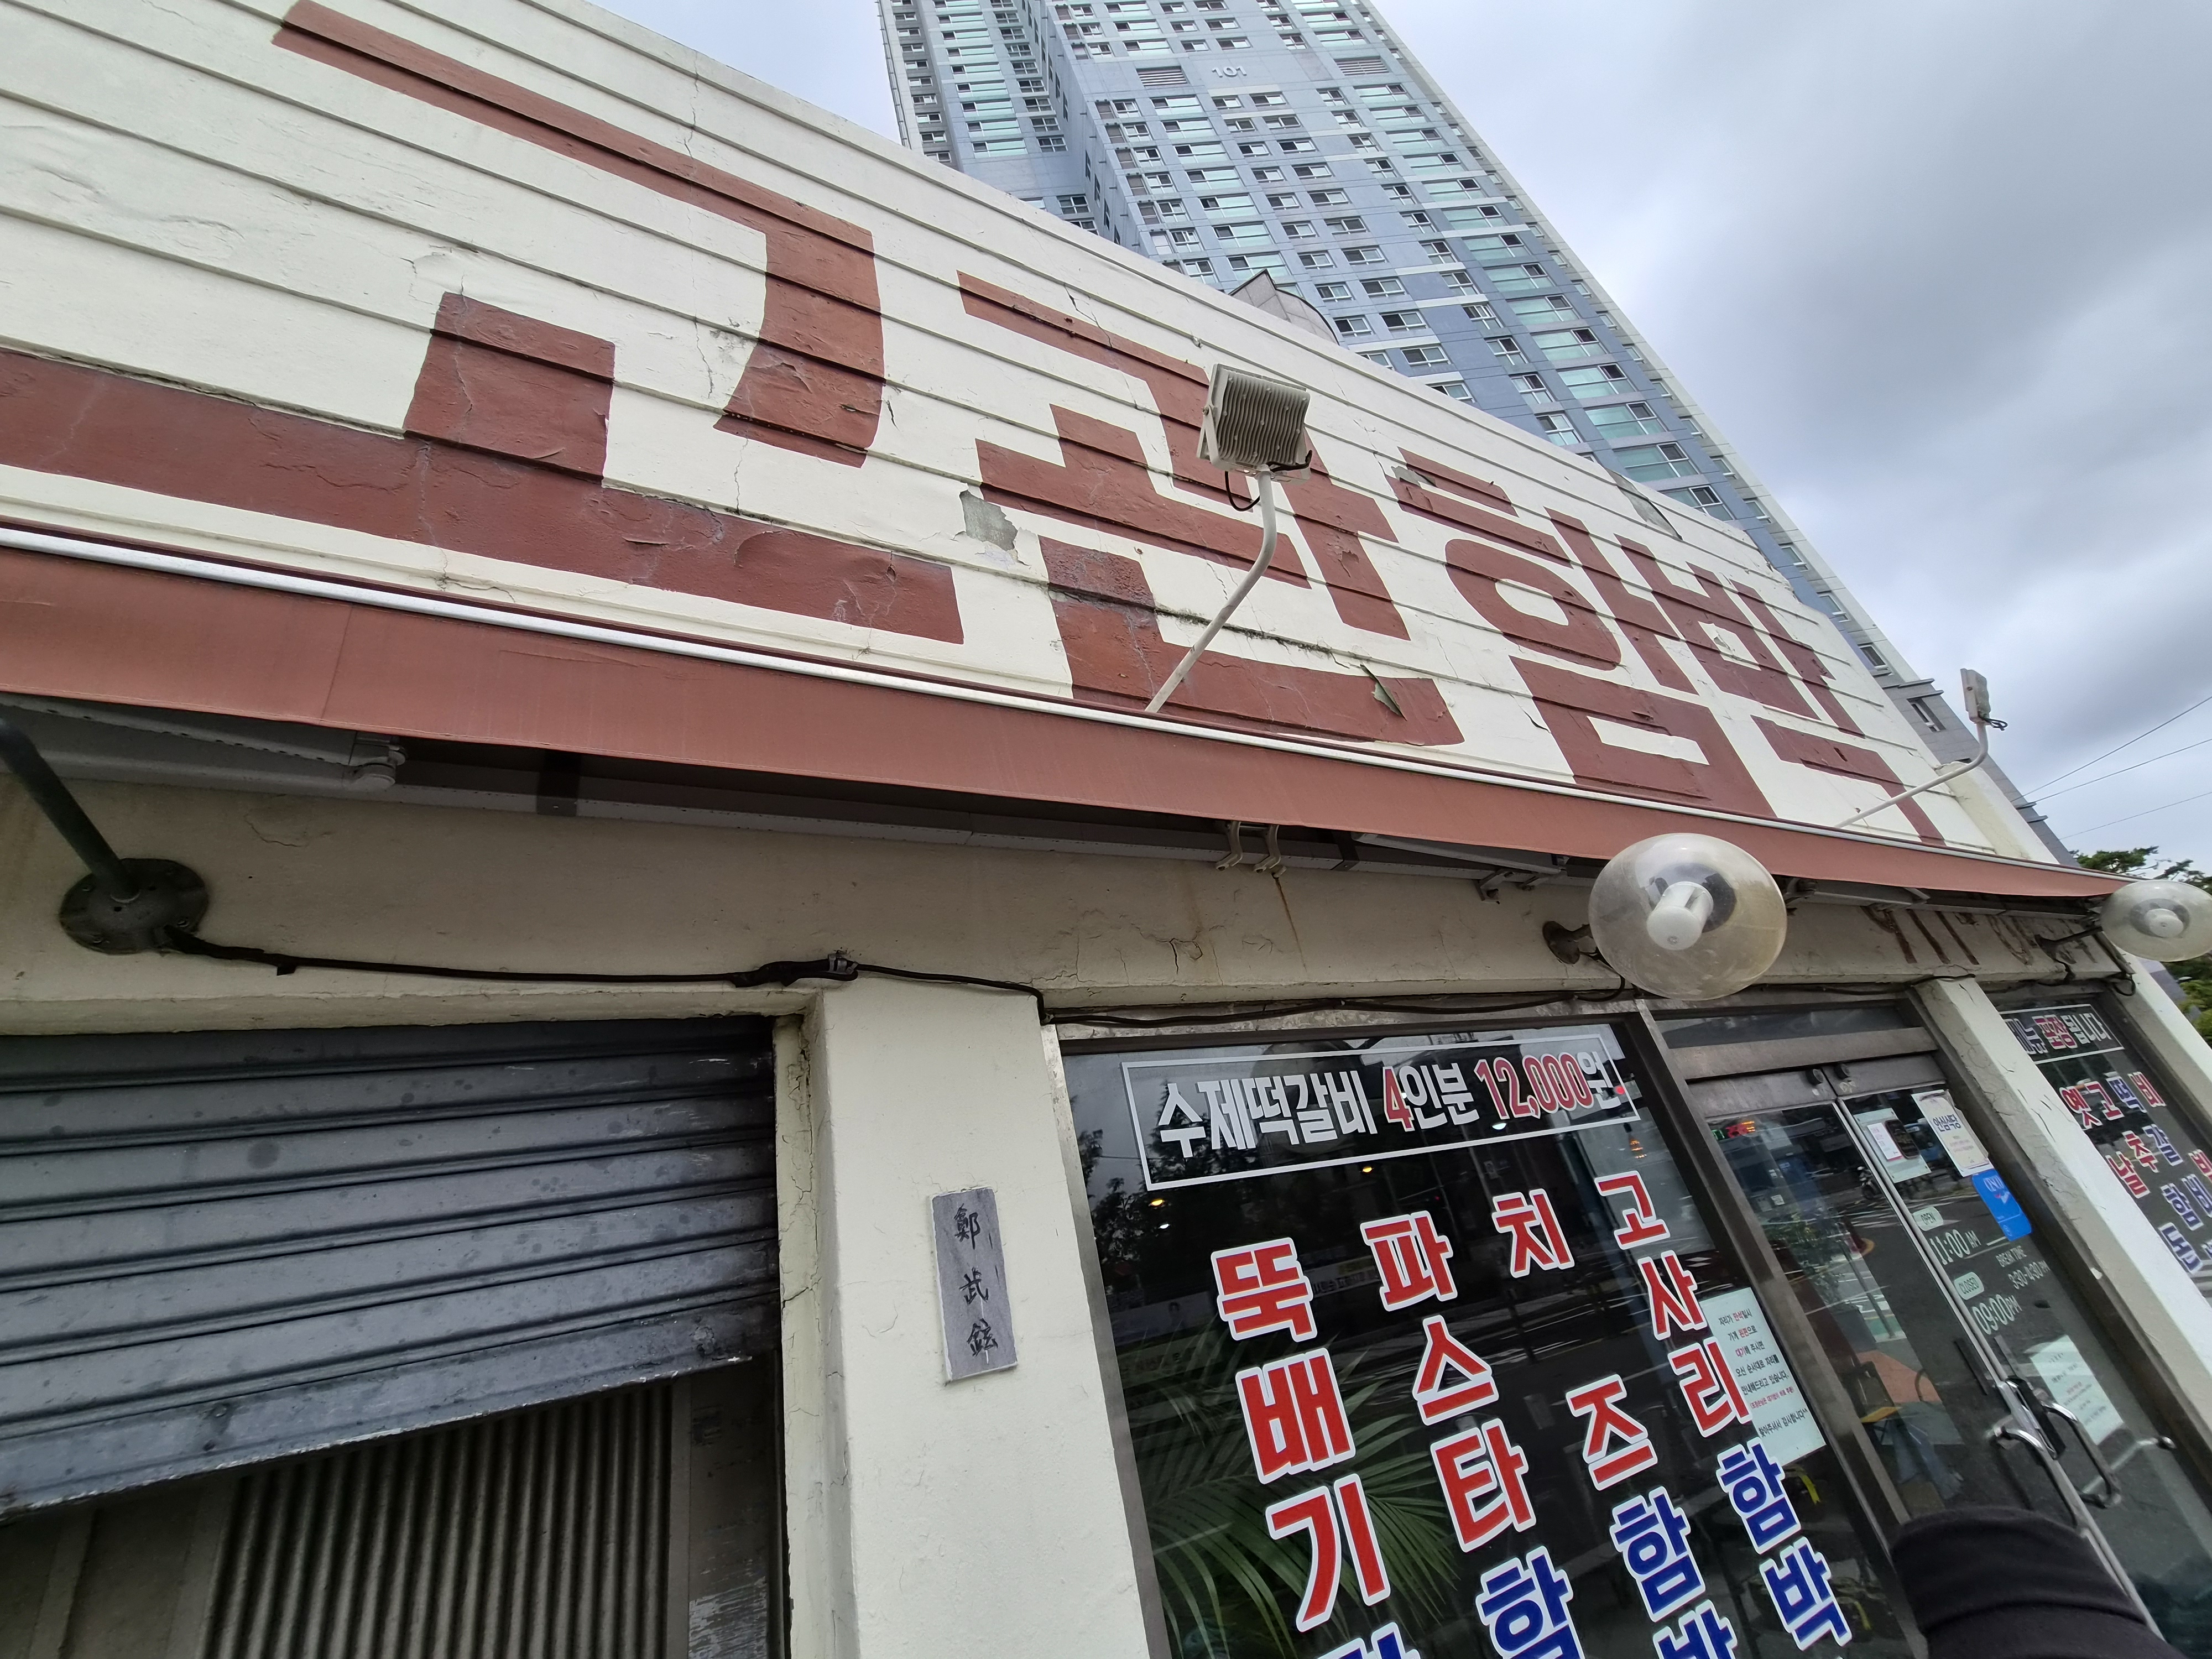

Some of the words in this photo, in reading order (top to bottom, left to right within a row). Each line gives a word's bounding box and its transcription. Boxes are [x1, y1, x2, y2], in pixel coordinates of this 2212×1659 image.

[1212, 66, 1247, 78] 101
[1160, 1071, 1378, 1157] 수제떡갈비
[1382, 1063, 1478, 1131] 4인분
[1474, 1050, 1621, 1119] 12,000원
[1932, 1114, 1961, 1132] 안심식당
[1920, 1212, 1937, 1225] OPEN
[1929, 1229, 1970, 1265] 11:00
[1965, 1230, 1981, 1248] AM
[1996, 1249, 2017, 1267] BREAK
[2010, 1245, 2027, 1261] TIME
[1959, 1277, 1979, 1295] CLOSED
[1718, 1315, 1734, 1326] 자리가
[1728, 1332, 1739, 1342] 가게
[1735, 1346, 1751, 1357] 대기해
[1750, 1340, 1765, 1352] 주시면
[1735, 1366, 1747, 1377] 오신
[1747, 1360, 1765, 1373] 순서대로
[1765, 1354, 1780, 1366] 자리를
[1741, 1378, 1769, 1396] 안내해드리고
[1768, 1369, 1790, 1384] 있습니다.
